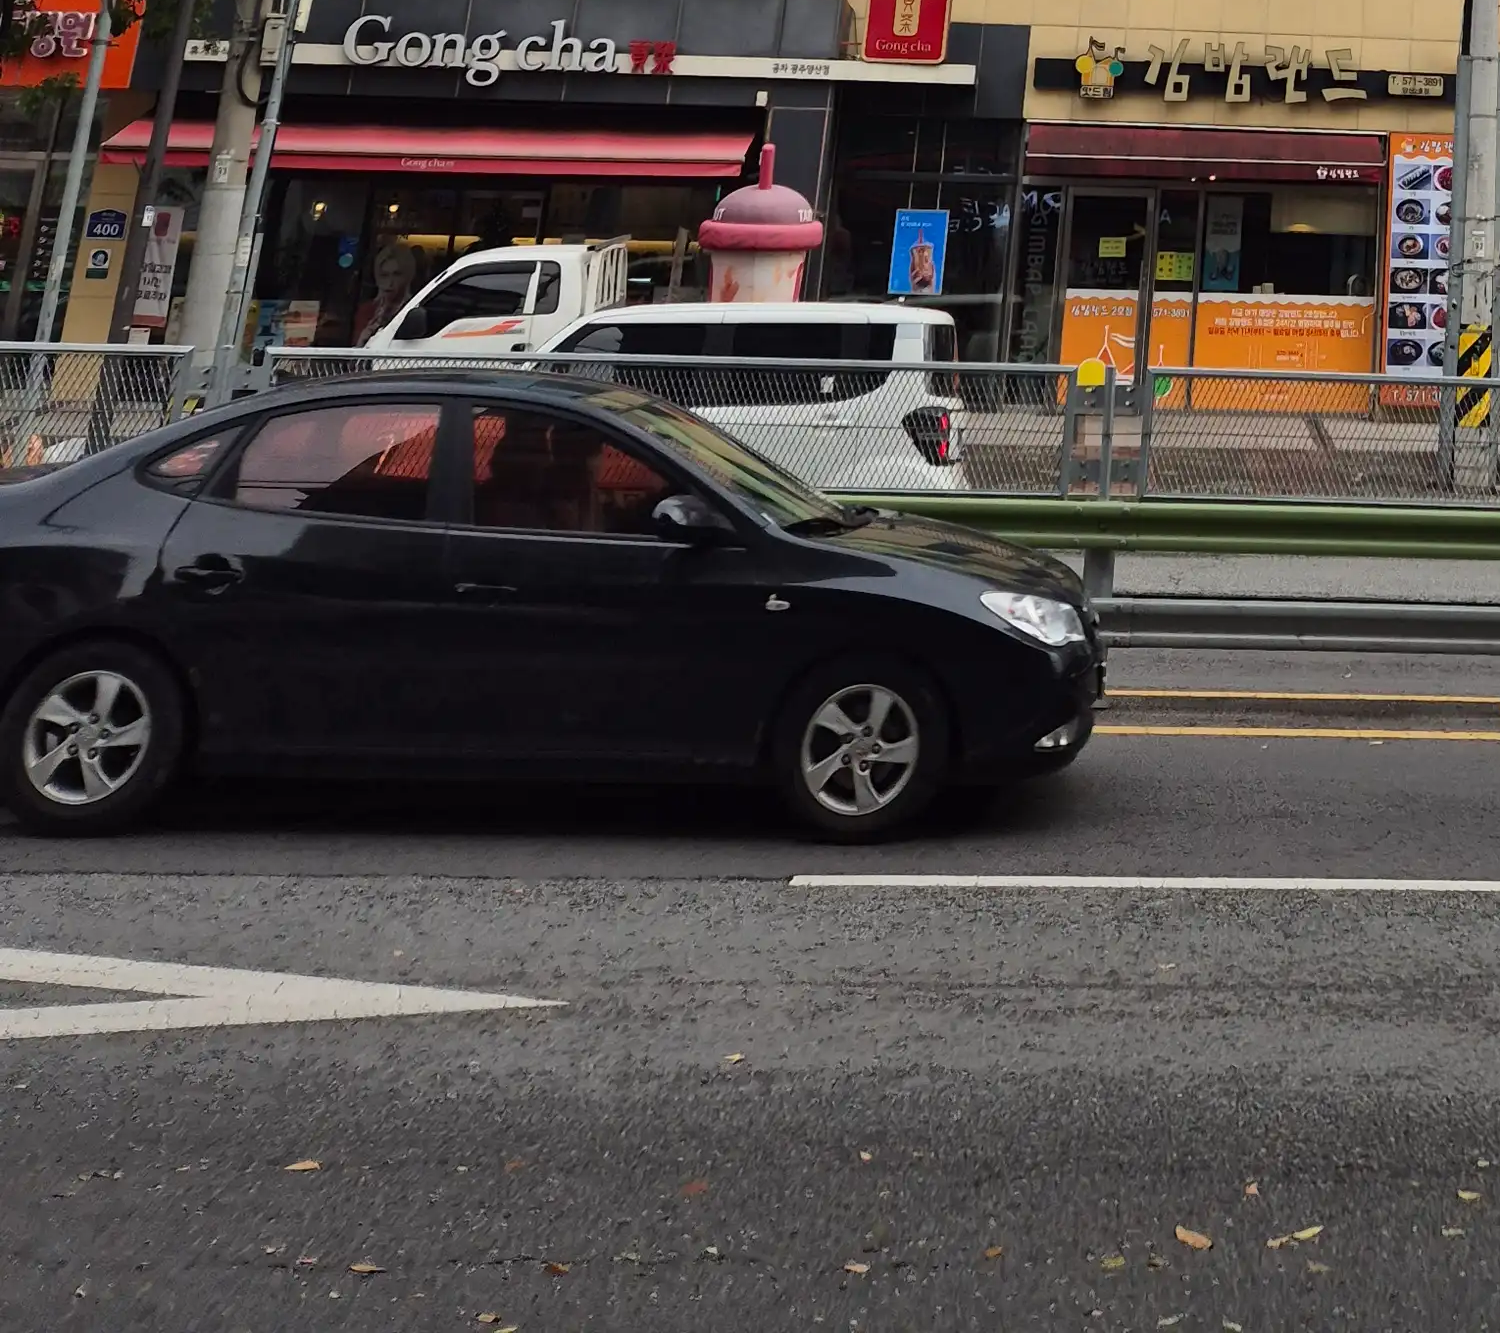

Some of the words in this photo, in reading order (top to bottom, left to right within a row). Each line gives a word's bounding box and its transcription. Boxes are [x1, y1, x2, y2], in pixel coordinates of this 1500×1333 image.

[343, 14, 508, 87] Gong
[515, 19, 619, 73] cha
[875, 39, 909, 54] Gong
[910, 40, 932, 52] cha
[1143, 37, 1369, 105] 김밥랜드
[93, 223, 120, 236] 400
